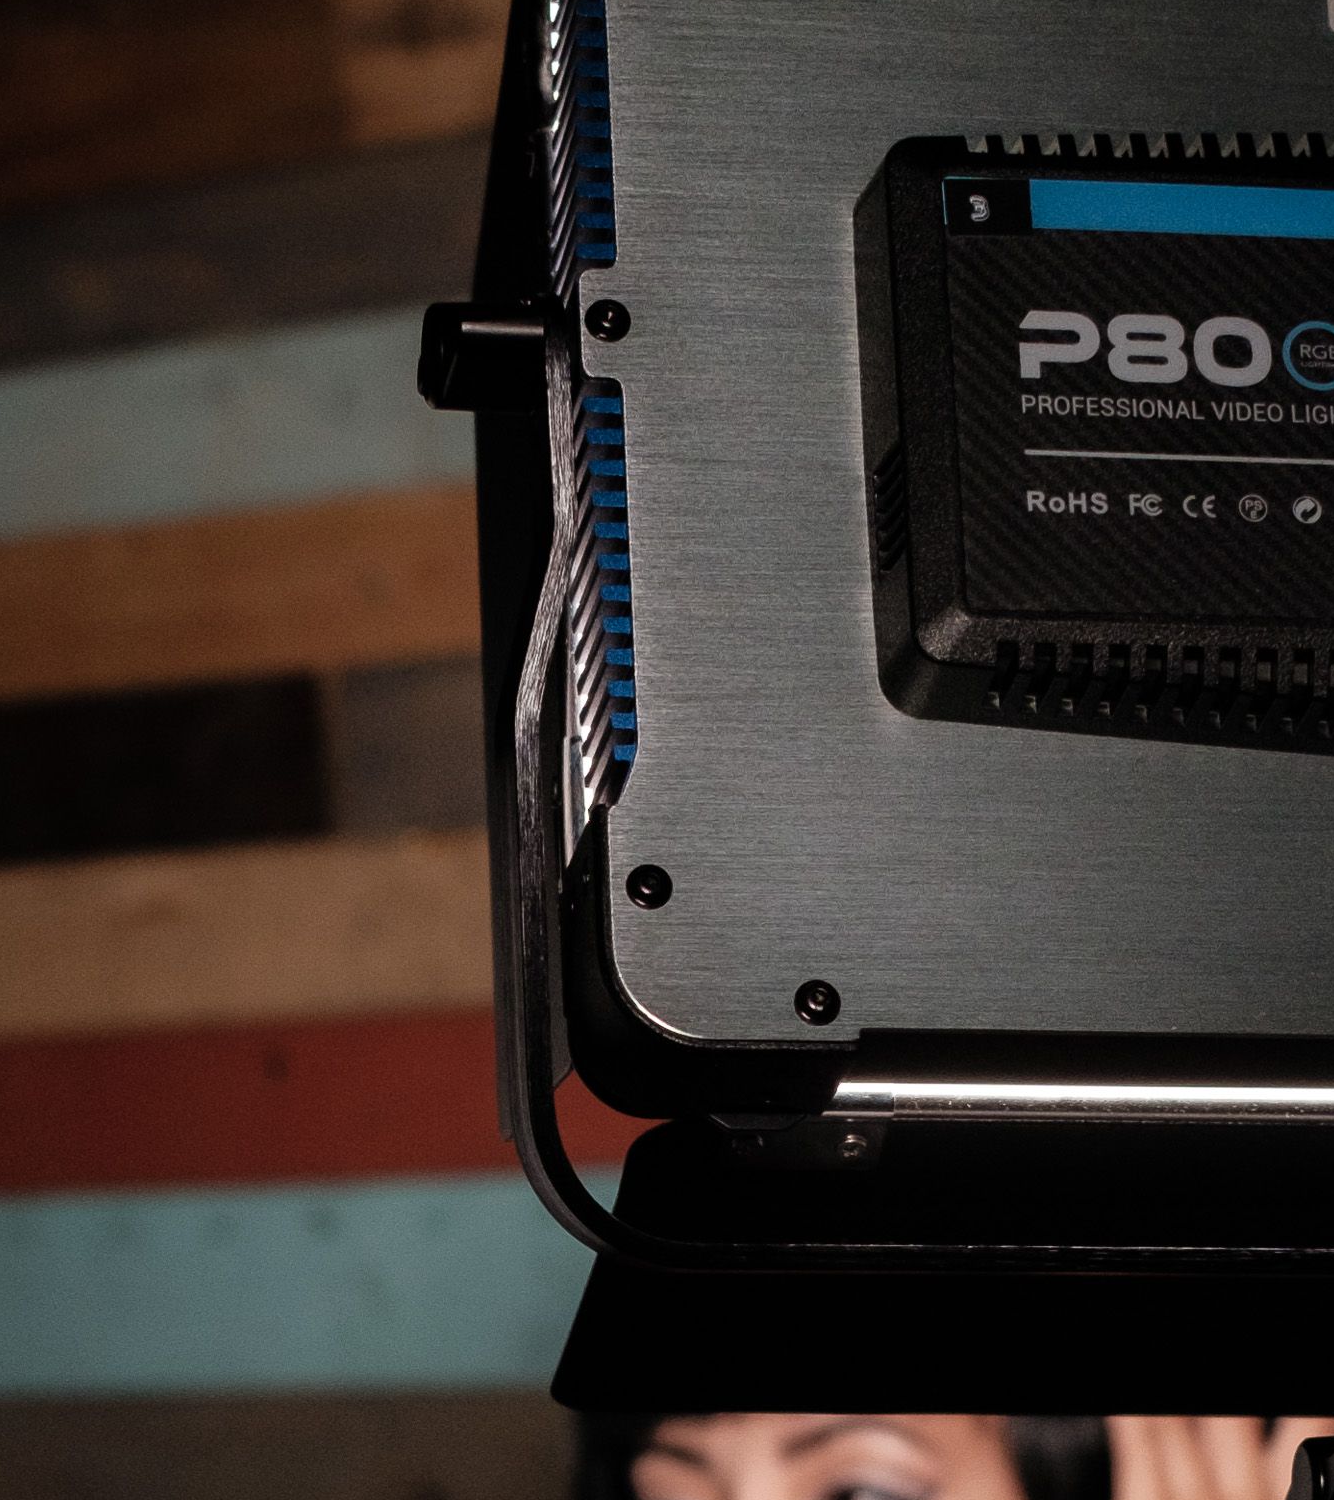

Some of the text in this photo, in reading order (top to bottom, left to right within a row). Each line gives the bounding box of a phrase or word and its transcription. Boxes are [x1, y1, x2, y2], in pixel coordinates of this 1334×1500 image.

[1018, 310, 1273, 388] P80
[1021, 393, 1205, 422] PROFESSIONAL
[1212, 401, 1283, 423] VIDEO
[1026, 490, 1109, 515] RoHS
[1183, 494, 1217, 519] CE
